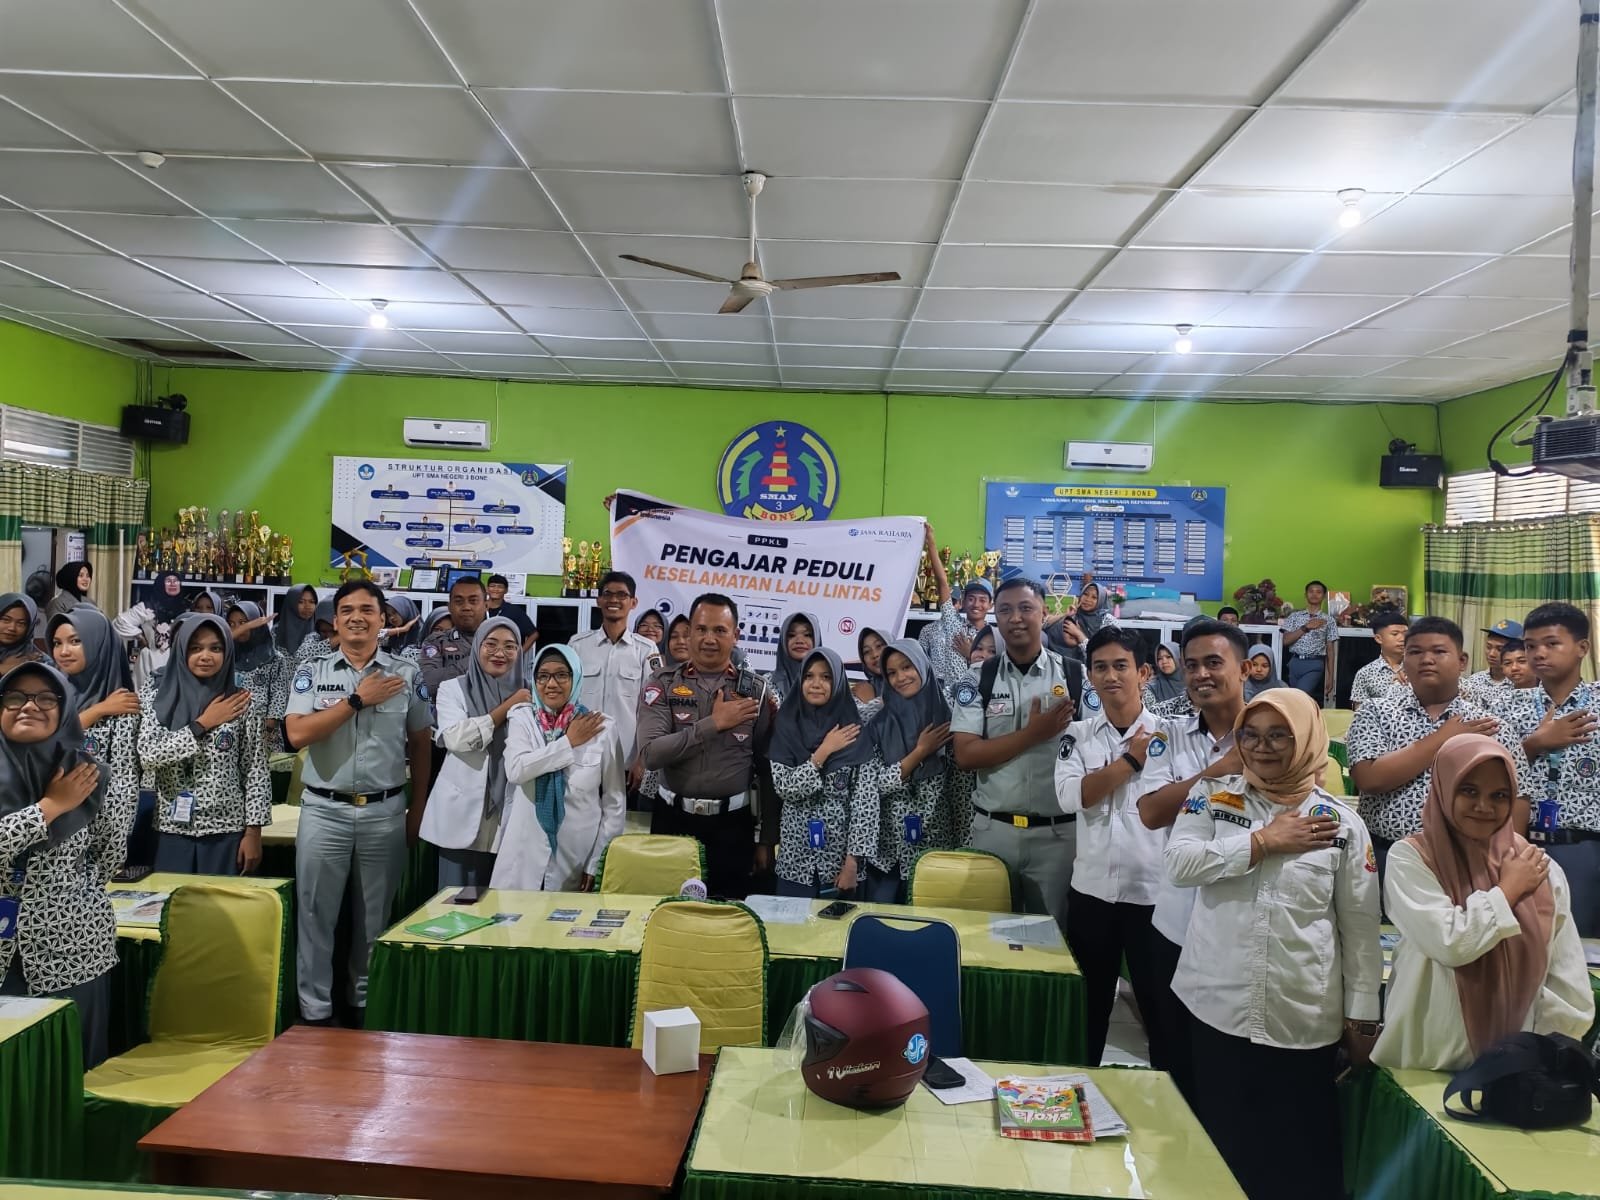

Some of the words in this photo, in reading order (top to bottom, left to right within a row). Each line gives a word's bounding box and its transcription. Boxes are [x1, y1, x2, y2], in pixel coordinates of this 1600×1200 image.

[388, 463, 443, 472] STRUKTUR
[447, 465, 513, 475] ORGANISASI
[760, 493, 798, 501] SMAN
[775, 501, 783, 511] 3
[760, 510, 797, 521] BONE
[878, 530, 912, 538] RAHARJA
[754, 537, 782, 546] PPKL
[660, 543, 788, 574] PENGAJAR
[792, 557, 875, 582] PEDULI
[643, 564, 773, 592] KESELAMATAN
[775, 578, 821, 596] LALU
[822, 583, 882, 603] LINTAS
[316, 684, 346, 693] FAIZAL
